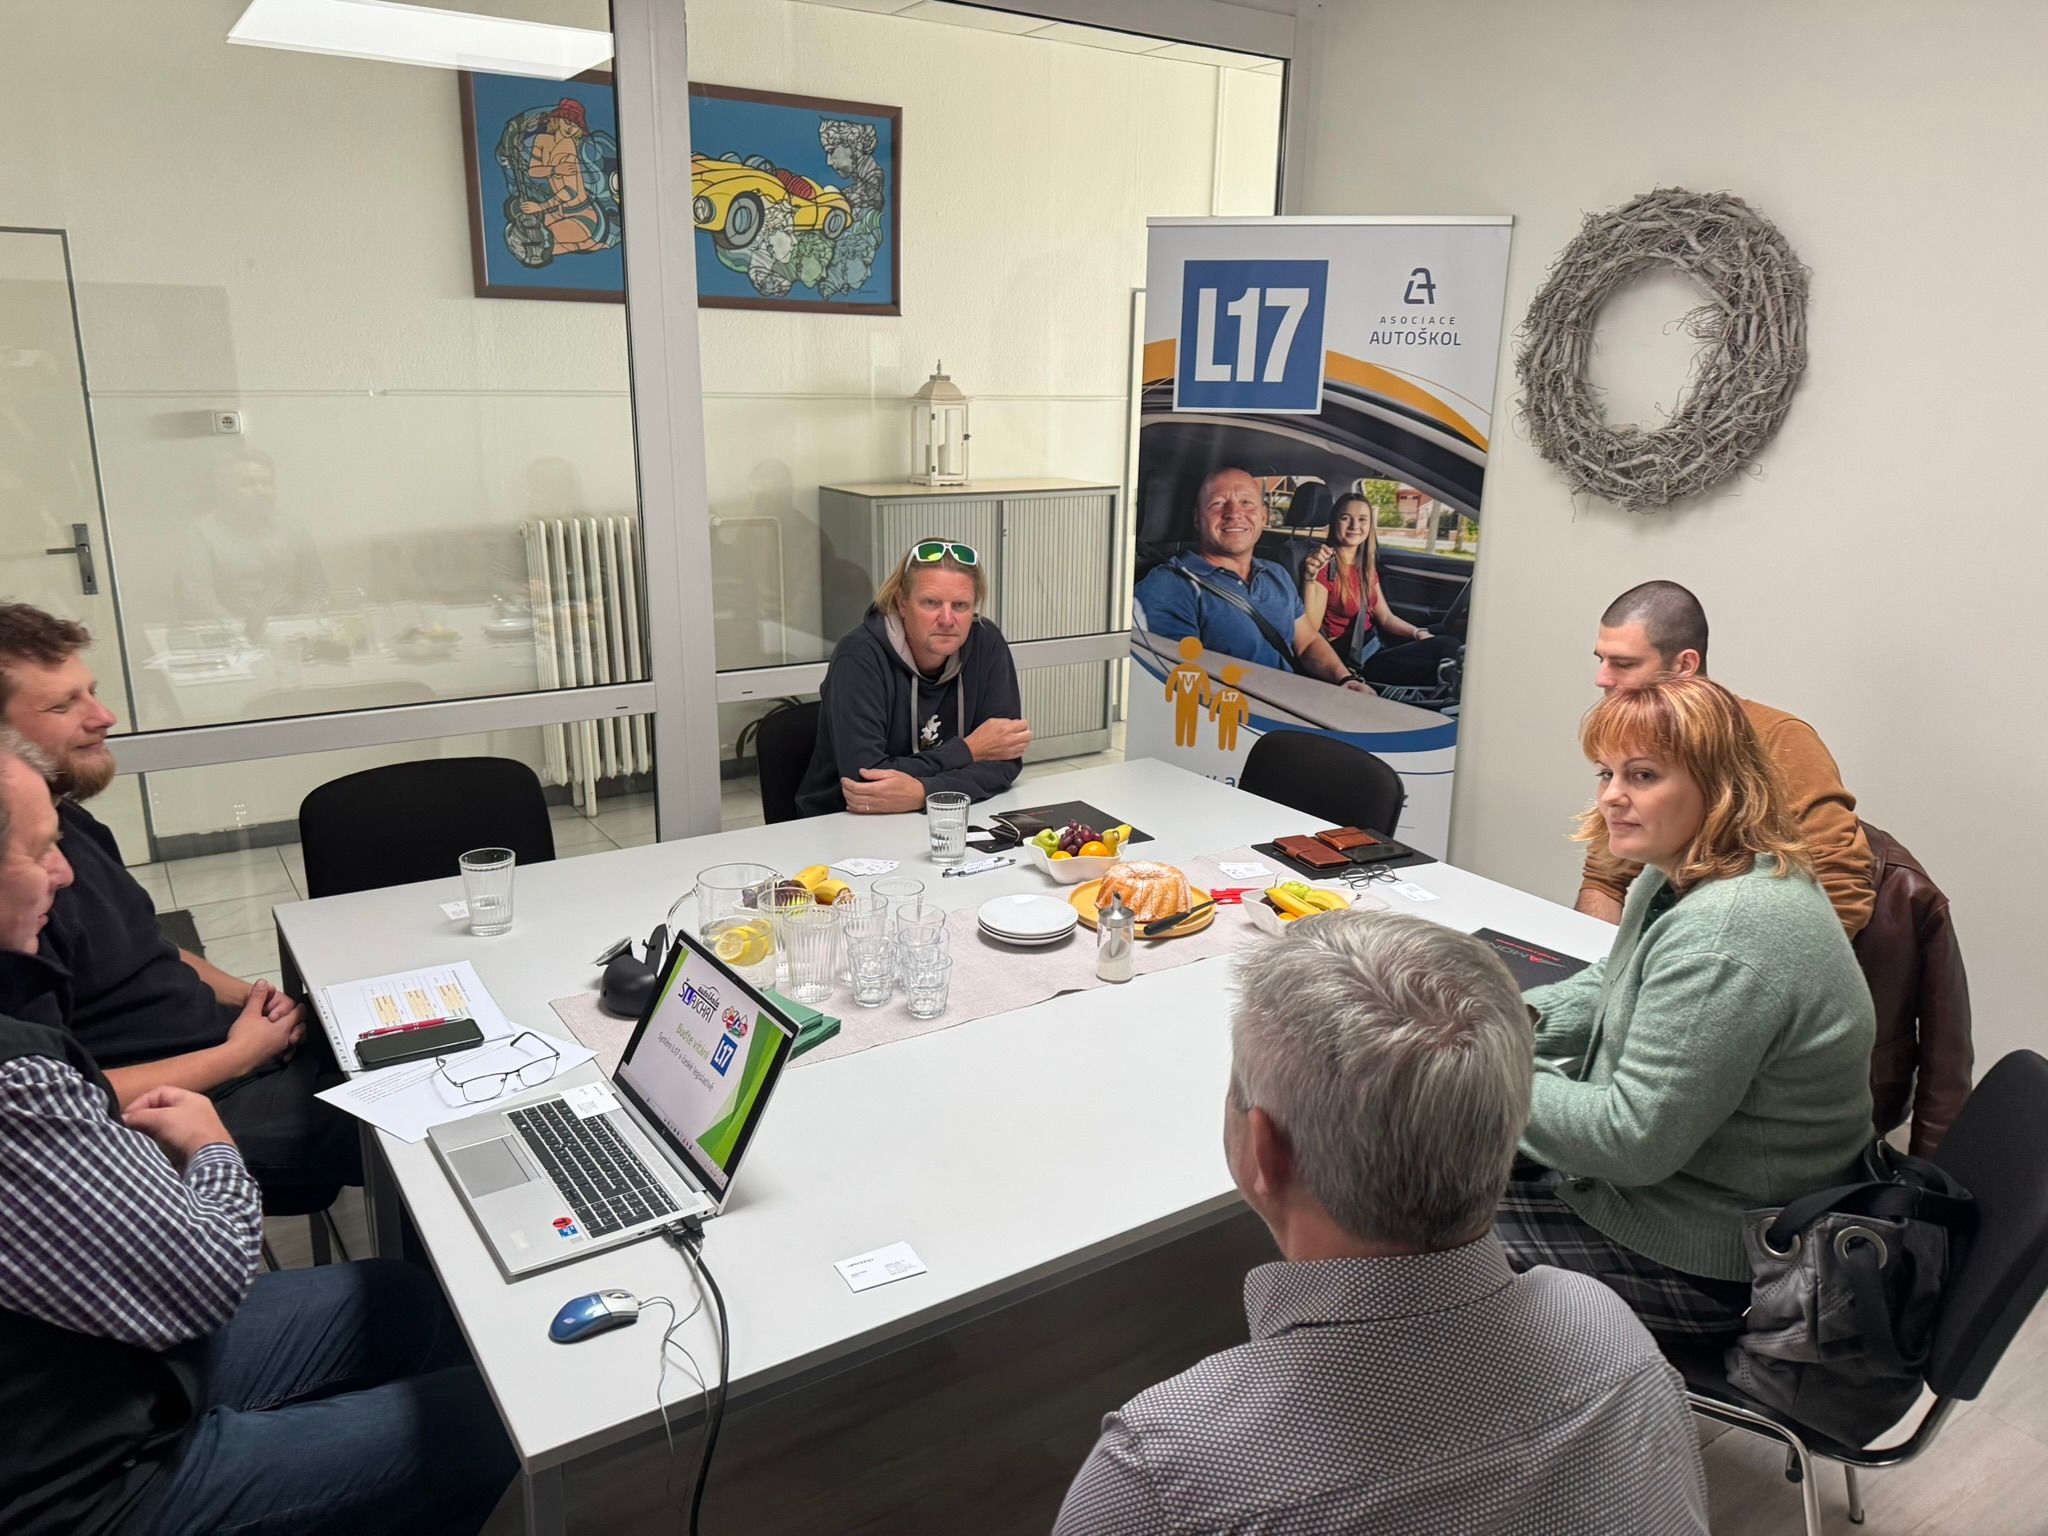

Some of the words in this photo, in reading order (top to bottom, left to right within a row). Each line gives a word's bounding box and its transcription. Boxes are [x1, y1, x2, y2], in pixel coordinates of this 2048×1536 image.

[1379, 315, 1456, 325] ASOCIACE
[1194, 287, 1311, 383] L17
[1369, 327, 1462, 346] AUTOŠKOL
[1222, 690, 1239, 702] L17
[714, 1039, 734, 1069] L17
